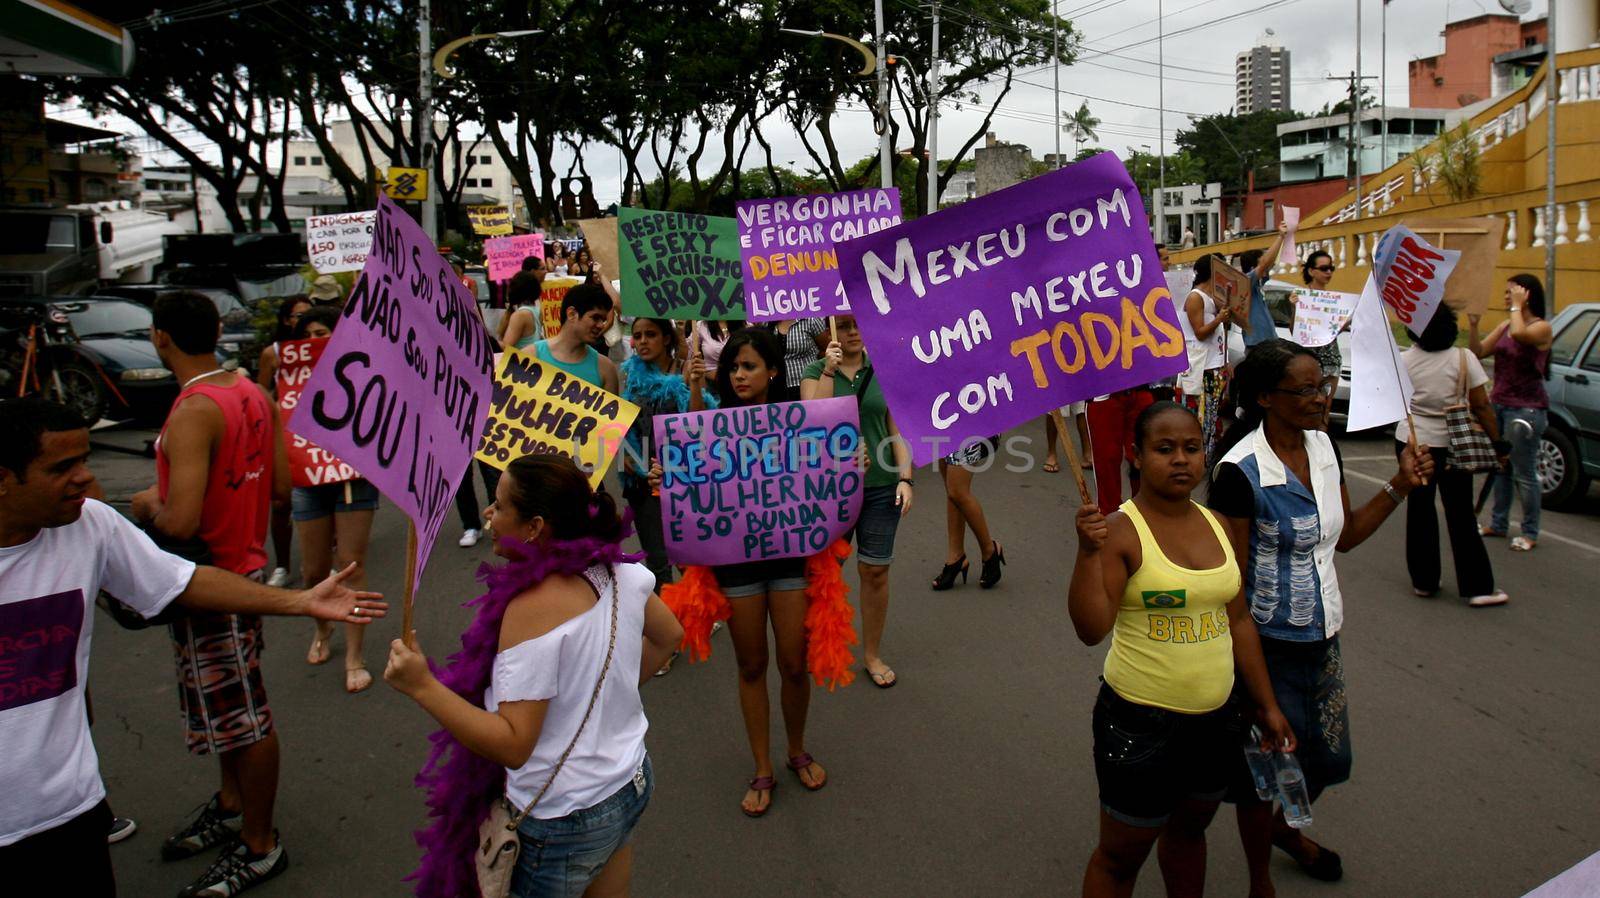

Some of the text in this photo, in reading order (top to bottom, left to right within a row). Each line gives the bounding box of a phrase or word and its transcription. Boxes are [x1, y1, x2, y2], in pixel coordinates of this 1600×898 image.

[621, 213, 708, 241] RESPEITO
[737, 190, 892, 228] VERGONHA
[312, 241, 335, 255] 150
[650, 232, 719, 259] SEXY
[740, 228, 752, 248] É
[861, 188, 1131, 315] MEXEU COM
[637, 254, 743, 287] MACHISMO
[372, 203, 406, 281] NÃO
[436, 268, 495, 385] SANTA
[645, 276, 746, 318] BROXA
[911, 253, 1143, 364] UMA MEXEU
[282, 343, 312, 364] SE
[344, 272, 401, 344] NÃO
[434, 345, 479, 456] PUTA
[502, 353, 542, 388] NA
[931, 287, 1184, 430] COM TODAS
[281, 390, 301, 410] S
[312, 352, 407, 469] SOU
[491, 381, 597, 446] MULHER
[664, 402, 806, 447] EU QUERO
[670, 468, 860, 516] MULHER NÃO
[670, 511, 684, 542] É
[746, 502, 827, 535] BUNDA
[837, 499, 850, 523] E
[743, 526, 829, 559] PEITO
